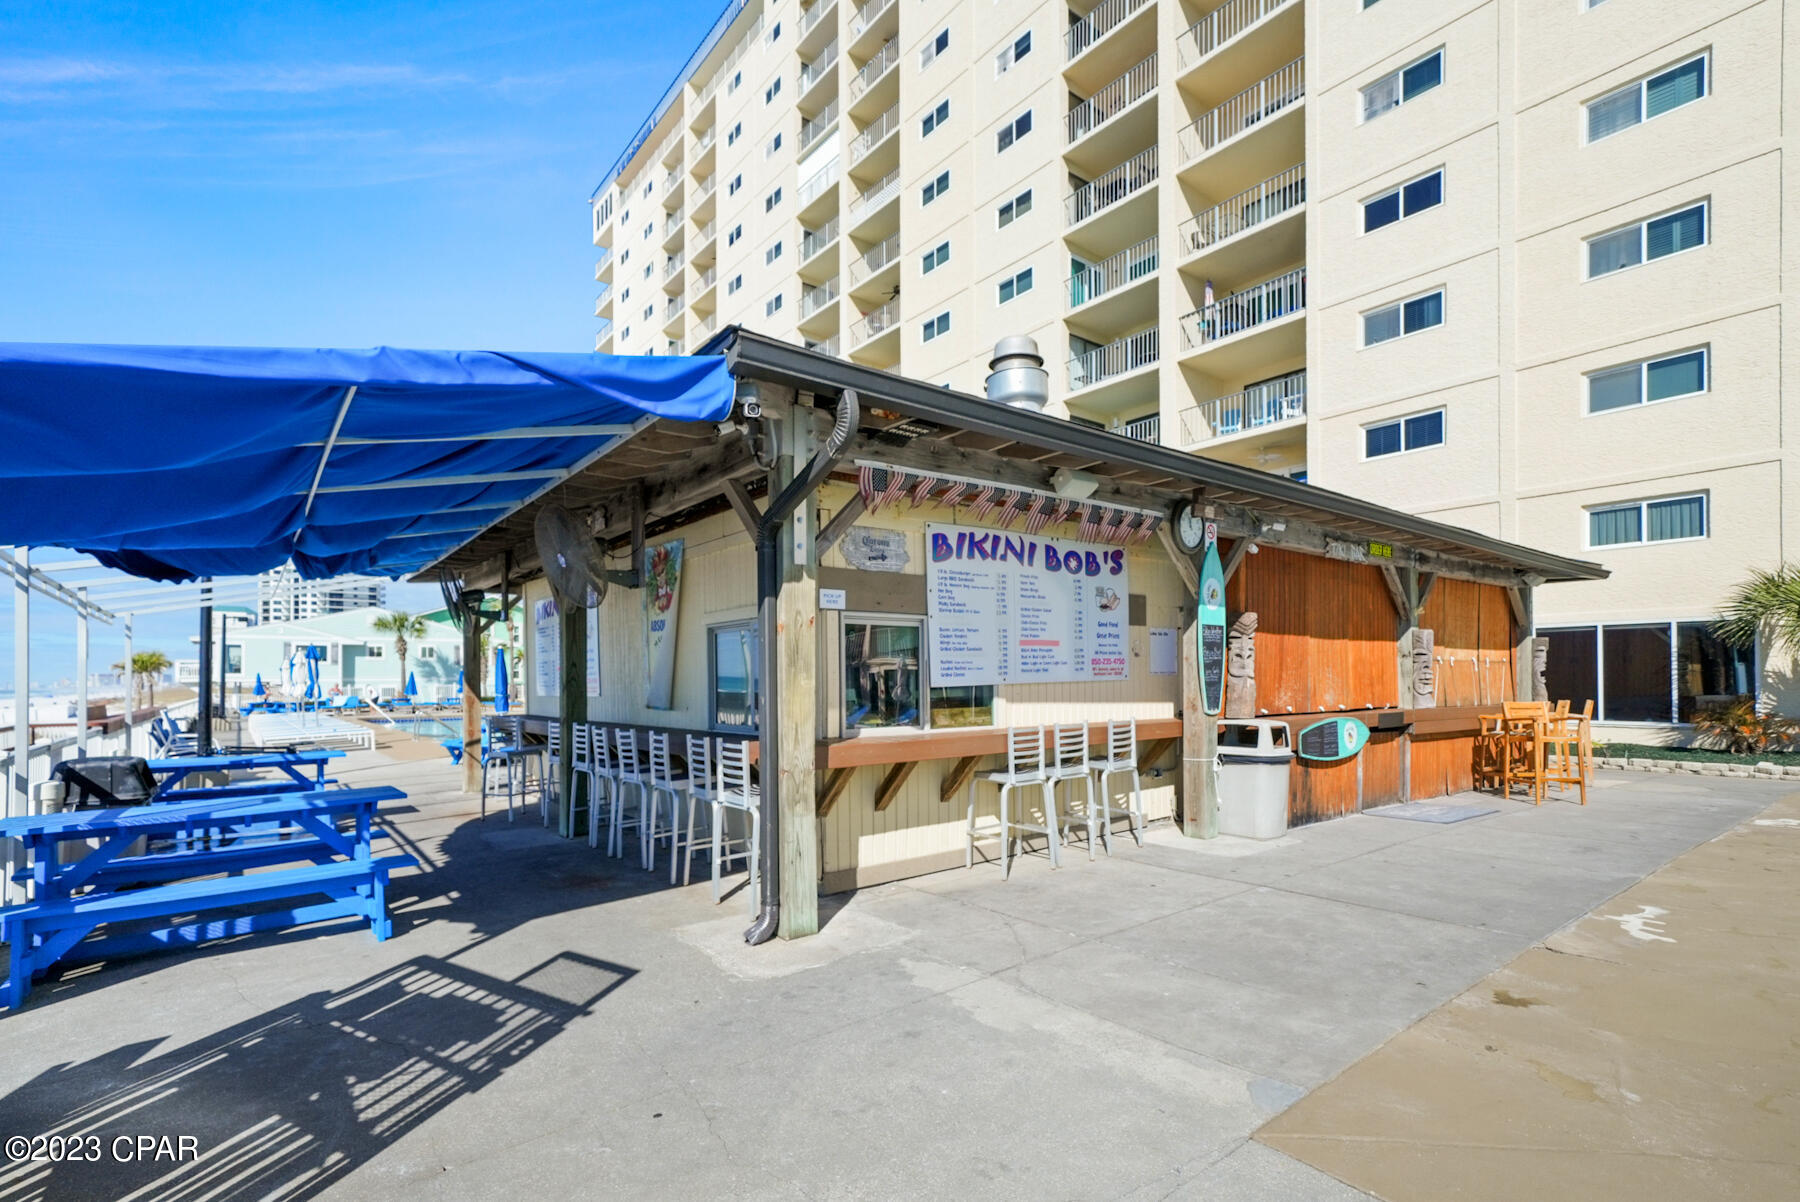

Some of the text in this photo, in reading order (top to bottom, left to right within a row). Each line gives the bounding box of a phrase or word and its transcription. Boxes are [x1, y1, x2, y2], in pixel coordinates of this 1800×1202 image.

[862, 536, 890, 547] Corona
[931, 531, 1124, 577] BIKINI BOB'S
[1370, 543, 1393, 558] ORDER HERE
